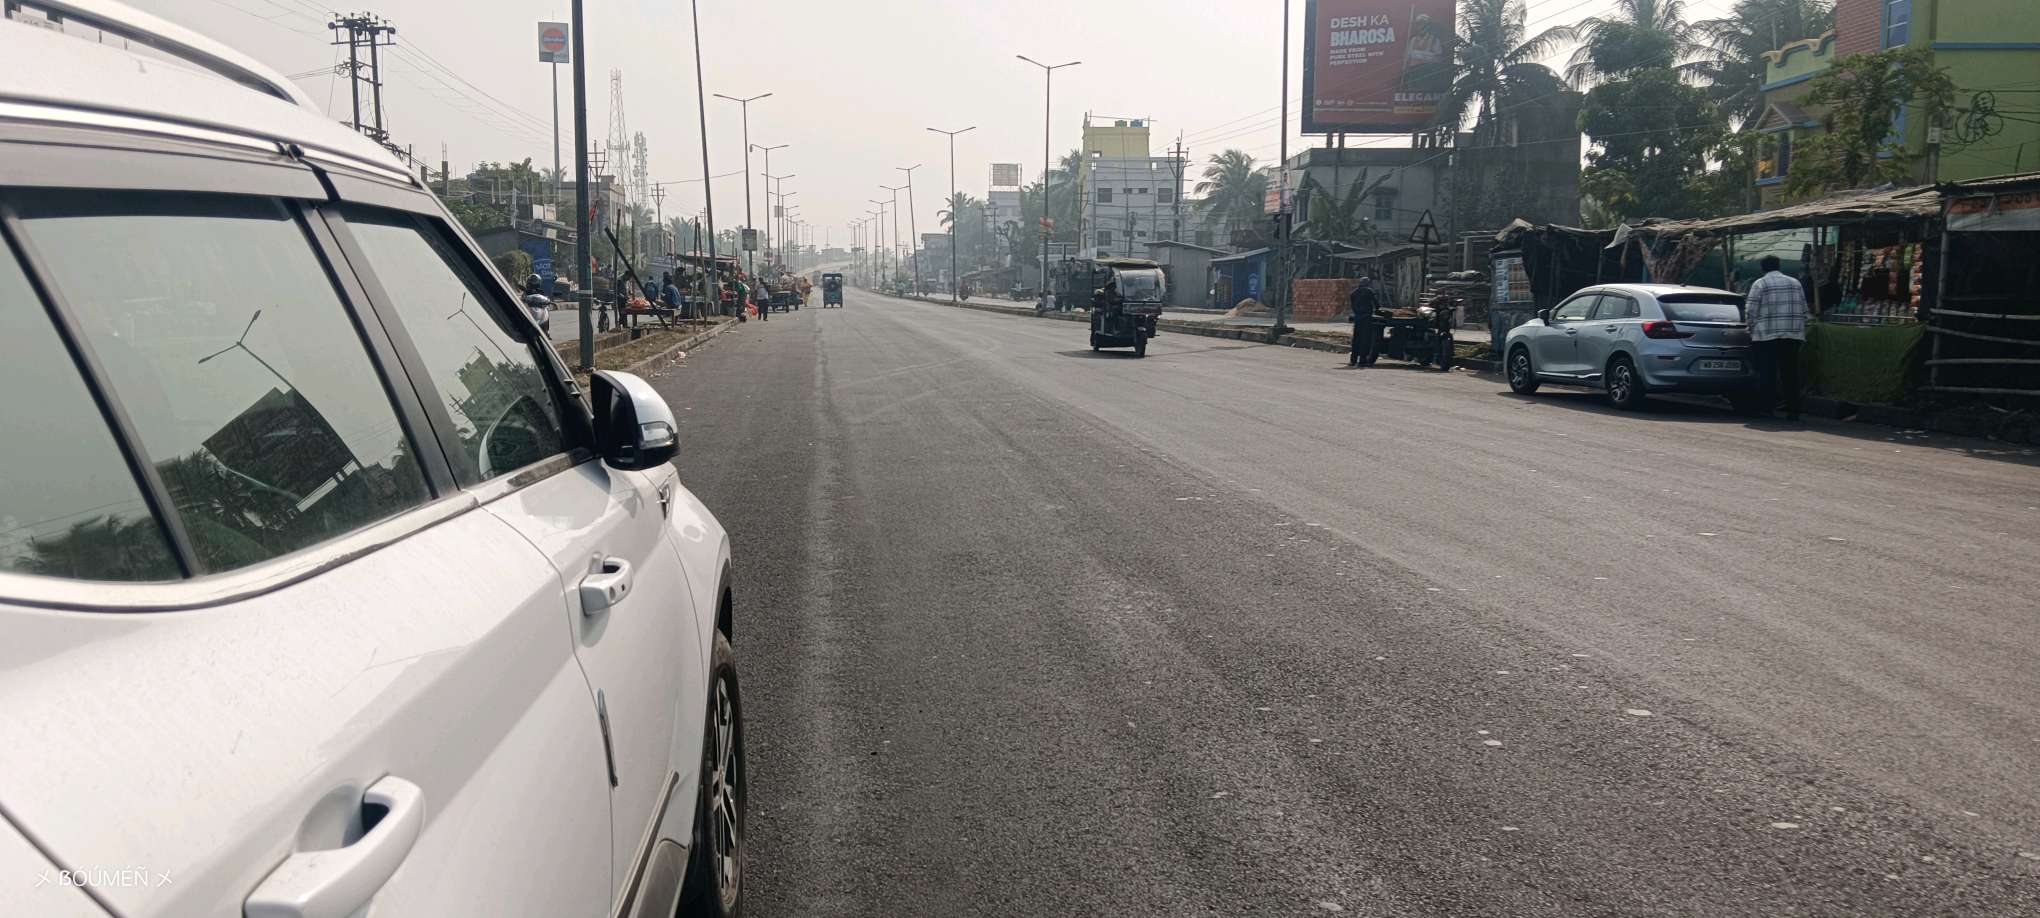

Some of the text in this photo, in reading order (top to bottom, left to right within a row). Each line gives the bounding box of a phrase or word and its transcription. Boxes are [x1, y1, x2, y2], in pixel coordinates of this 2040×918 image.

[1330, 15, 1389, 29] DESH KA
[1331, 27, 1395, 46] BHAROSA
